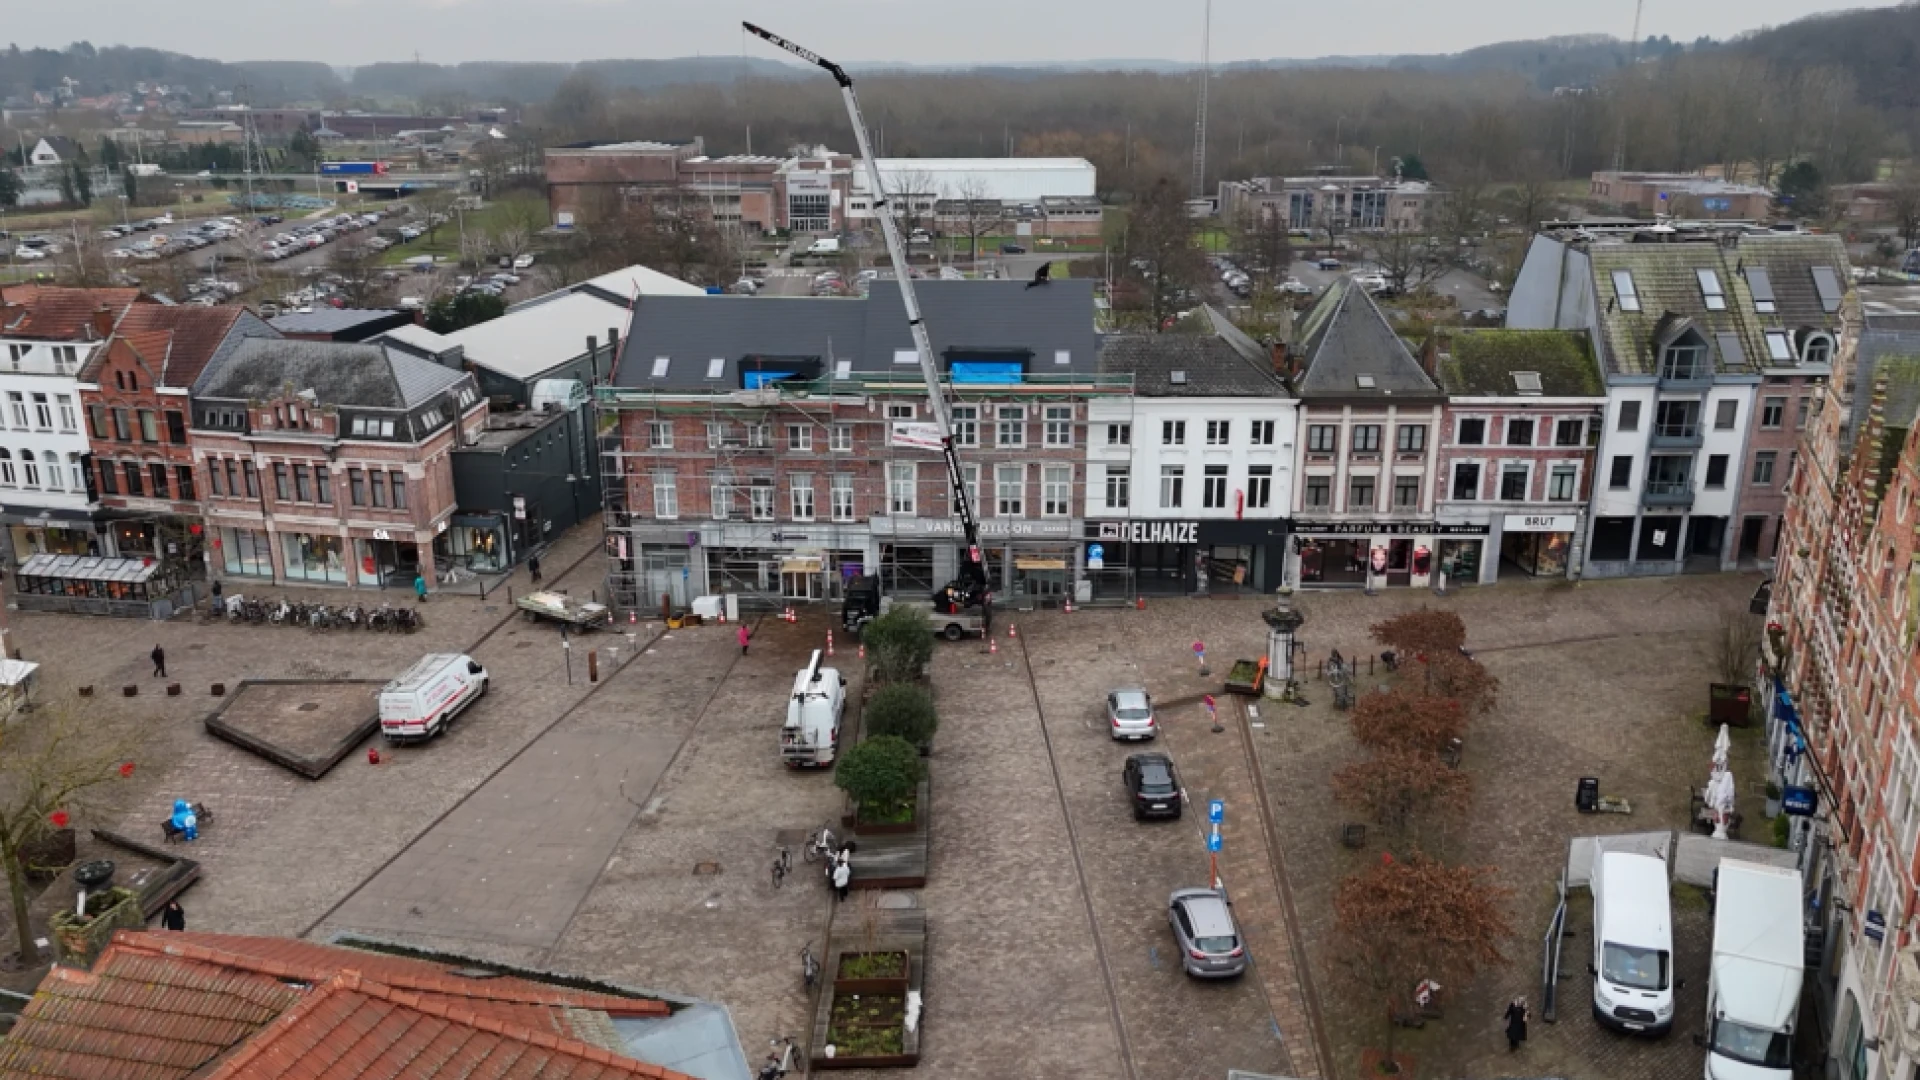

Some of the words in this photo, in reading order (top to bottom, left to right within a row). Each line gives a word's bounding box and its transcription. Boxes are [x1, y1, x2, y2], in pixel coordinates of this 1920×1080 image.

[1524, 516, 1555, 526] BRUT
[1121, 521, 1198, 543] DELHAIZE
[1211, 803, 1222, 816] P
